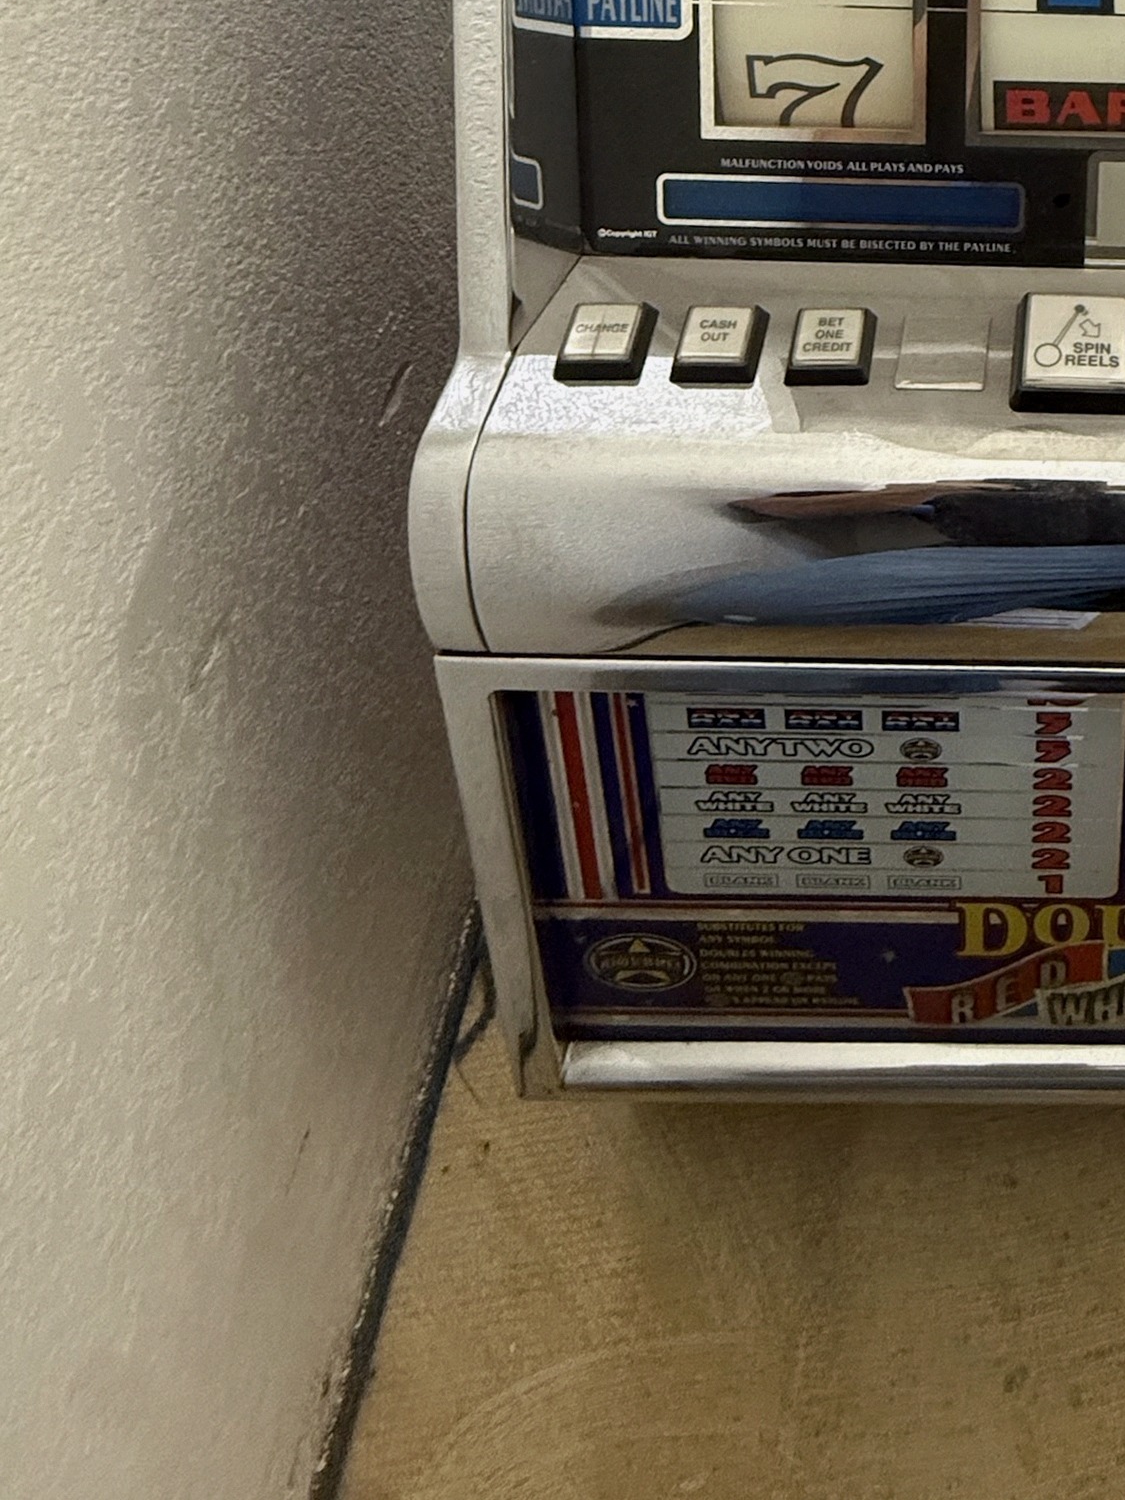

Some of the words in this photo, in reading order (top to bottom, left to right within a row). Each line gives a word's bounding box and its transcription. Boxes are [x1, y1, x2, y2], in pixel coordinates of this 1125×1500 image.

[744, 52, 884, 128] 7
[720, 157, 804, 171] MALFUNCTION
[806, 160, 843, 172] VOIDS
[847, 161, 868, 172] ALL
[870, 162, 905, 173] PLAYS
[907, 163, 932, 173] AND
[934, 163, 964, 174] PAYS
[669, 234, 690, 245] ALL
[693, 235, 747, 248] WINNING
[750, 236, 804, 248] SYMBOLS
[806, 238, 838, 250] MUST
[841, 240, 858, 250] BE
[860, 240, 916, 251] BISECTED
[919, 241, 935, 252] BY
[938, 241, 960, 252] THE
[575, 321, 629, 336] CHANGE
[698, 317, 739, 331] CASH
[818, 315, 844, 328] BET
[699, 330, 728, 343] OUT
[814, 328, 845, 340] ONE
[802, 340, 853, 354] CREDIT
[1072, 341, 1112, 356] SPIN
[1064, 354, 1120, 369] REELS
[688, 736, 778, 757] ANY
[777, 738, 875, 758] TWO
[701, 846, 788, 866] ANY
[786, 846, 872, 866] ONE
[951, 956, 1070, 1025] RED
